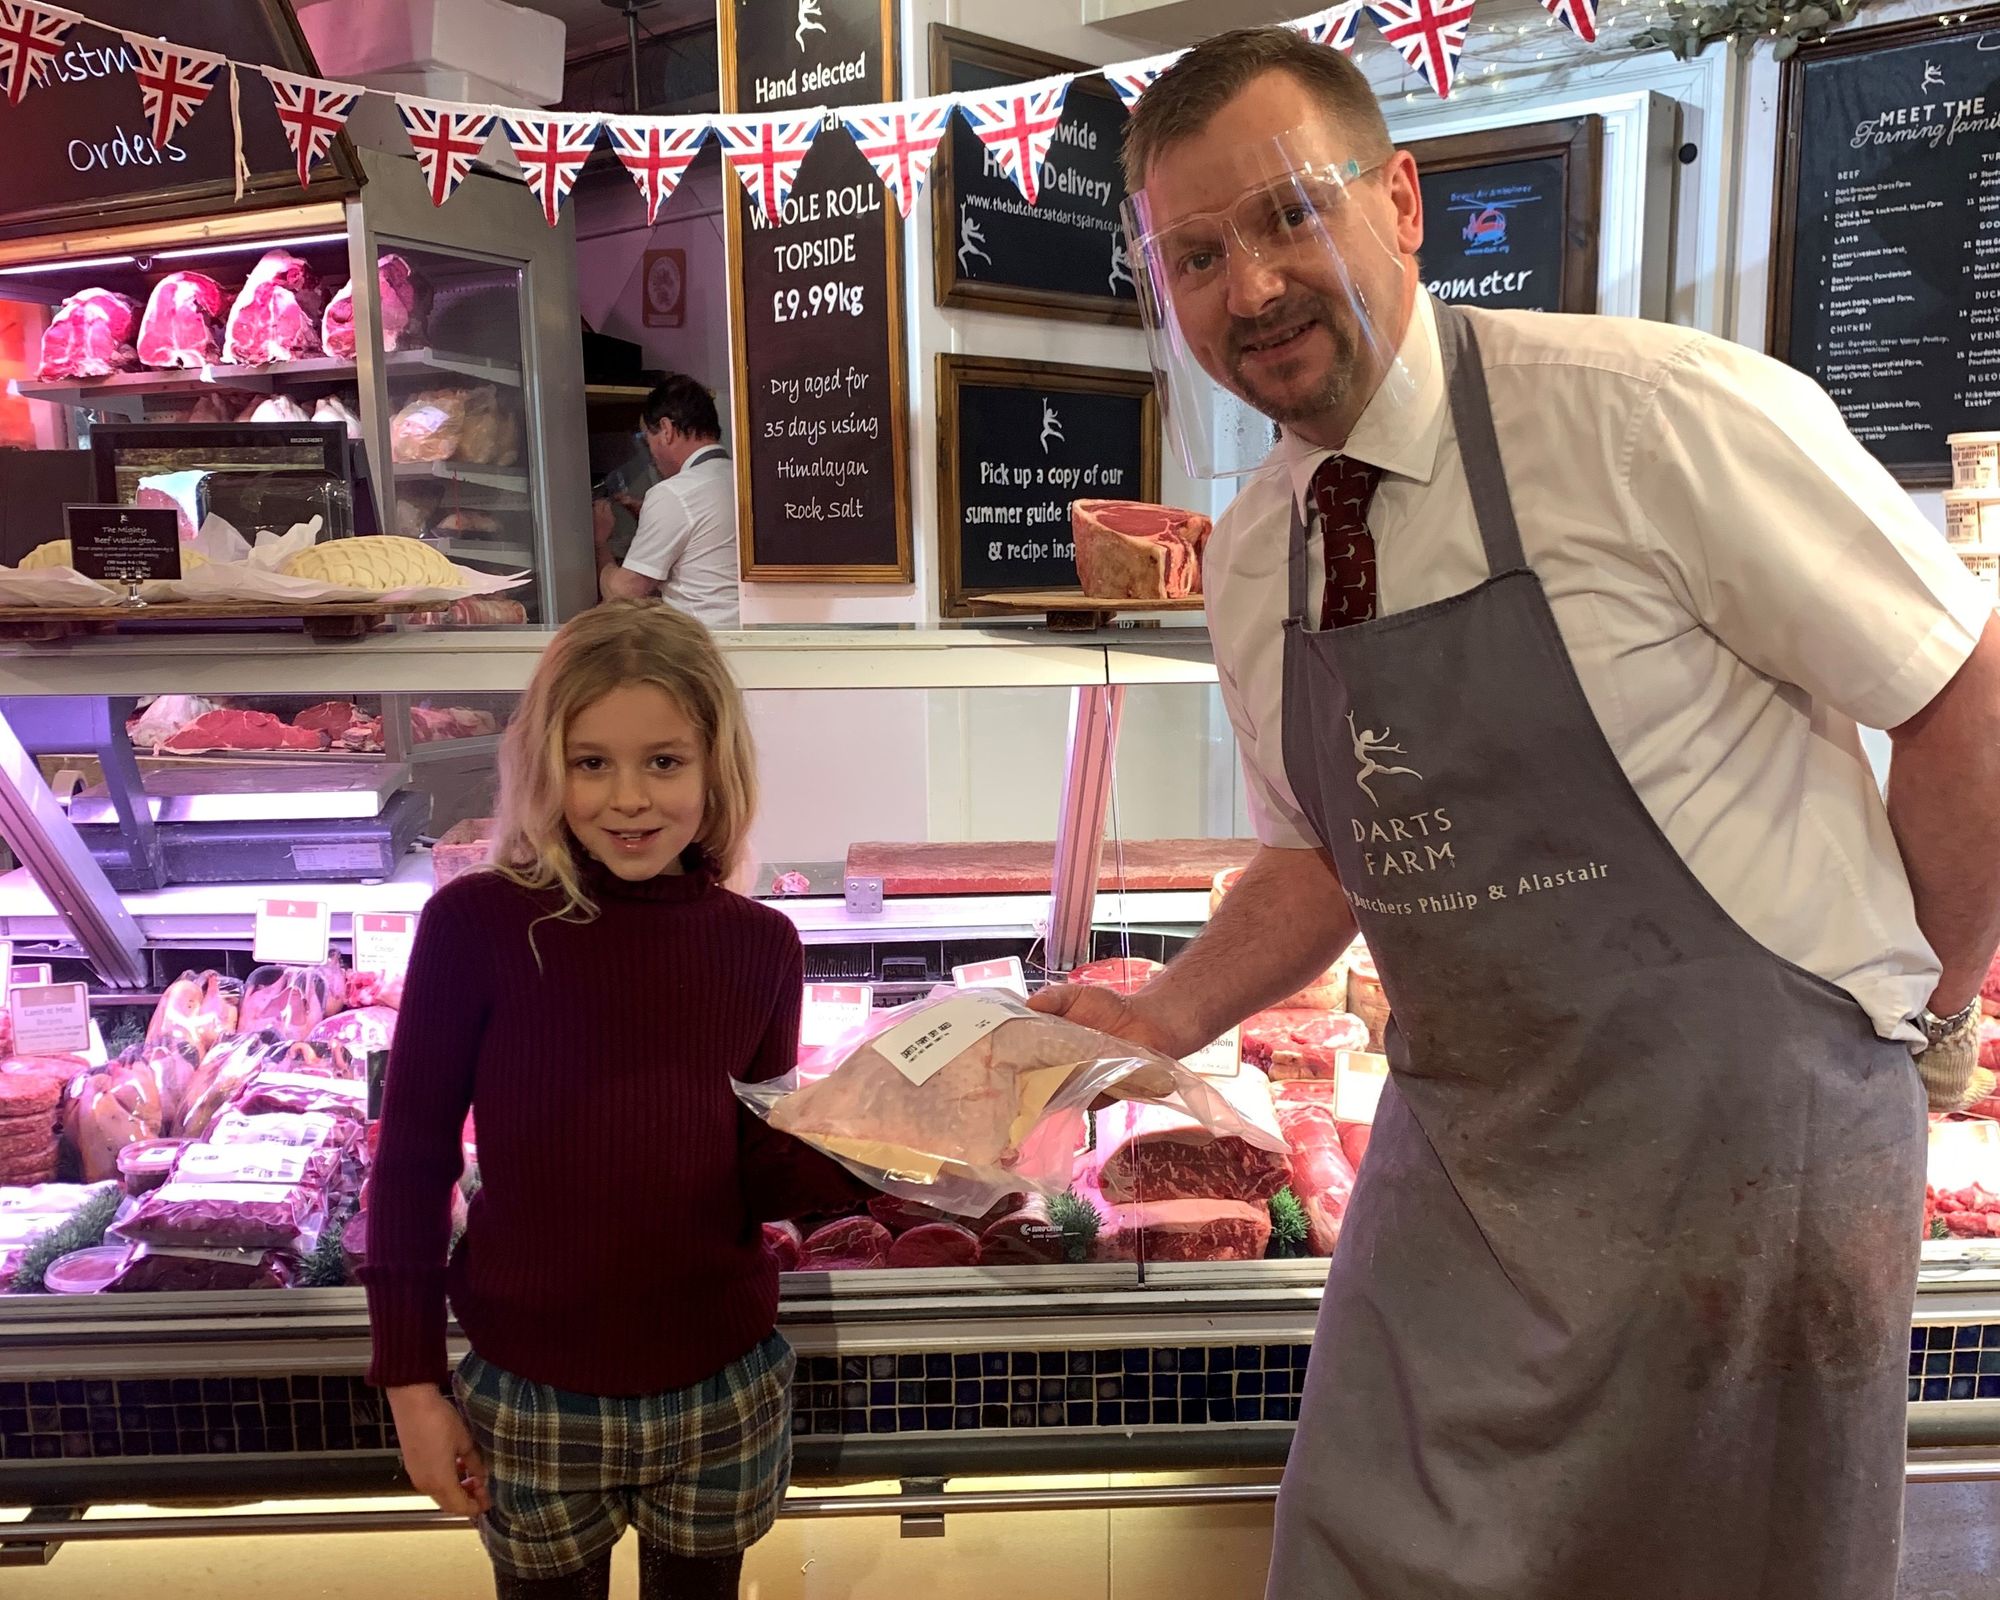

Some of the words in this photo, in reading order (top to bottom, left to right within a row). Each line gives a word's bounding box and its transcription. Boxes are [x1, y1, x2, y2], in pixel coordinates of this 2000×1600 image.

[756, 69, 797, 104] Hand
[802, 51, 866, 92] selected
[1879, 104, 1936, 128] MEET
[1943, 97, 1985, 119] THE
[1850, 120, 1947, 149] Farming
[1981, 152, 2000, 163] TUR
[1044, 161, 1112, 207] Delivery
[1837, 169, 1860, 181] BEEF
[826, 183, 880, 218] ROLL
[1979, 220, 2000, 230] GOO
[774, 234, 856, 273] TOPSIDE
[1833, 235, 1859, 245] LAMB
[774, 281, 864, 323] £9.99kg
[1830, 323, 1872, 335] CHICKEN
[1970, 330, 2000, 342] VENIS
[770, 378, 799, 403] Dry
[804, 368, 841, 398] aged
[845, 366, 869, 397] for
[764, 420, 784, 438] 35
[788, 416, 826, 445] days
[831, 412, 878, 439] using
[777, 457, 868, 487] Himalayan
[980, 461, 1010, 486] Pick
[1014, 467, 1032, 489] up
[1036, 468, 1044, 484] a
[1049, 466, 1081, 490] copy
[1083, 464, 1099, 486] of
[1101, 469, 1124, 486] our
[784, 496, 824, 520] Rock
[827, 498, 864, 519] Salt
[965, 505, 1022, 525] summer
[1027, 502, 1062, 527] guide
[988, 541, 1003, 561] &
[1007, 539, 1048, 563] recipe
[1351, 808, 1452, 843] DARTS
[1365, 842, 1455, 876] FARM
[1418, 892, 1478, 914] Philip
[1488, 884, 1507, 900] &
[1517, 862, 1609, 895] Alastair
[915, 1035, 931, 1047] FARM
